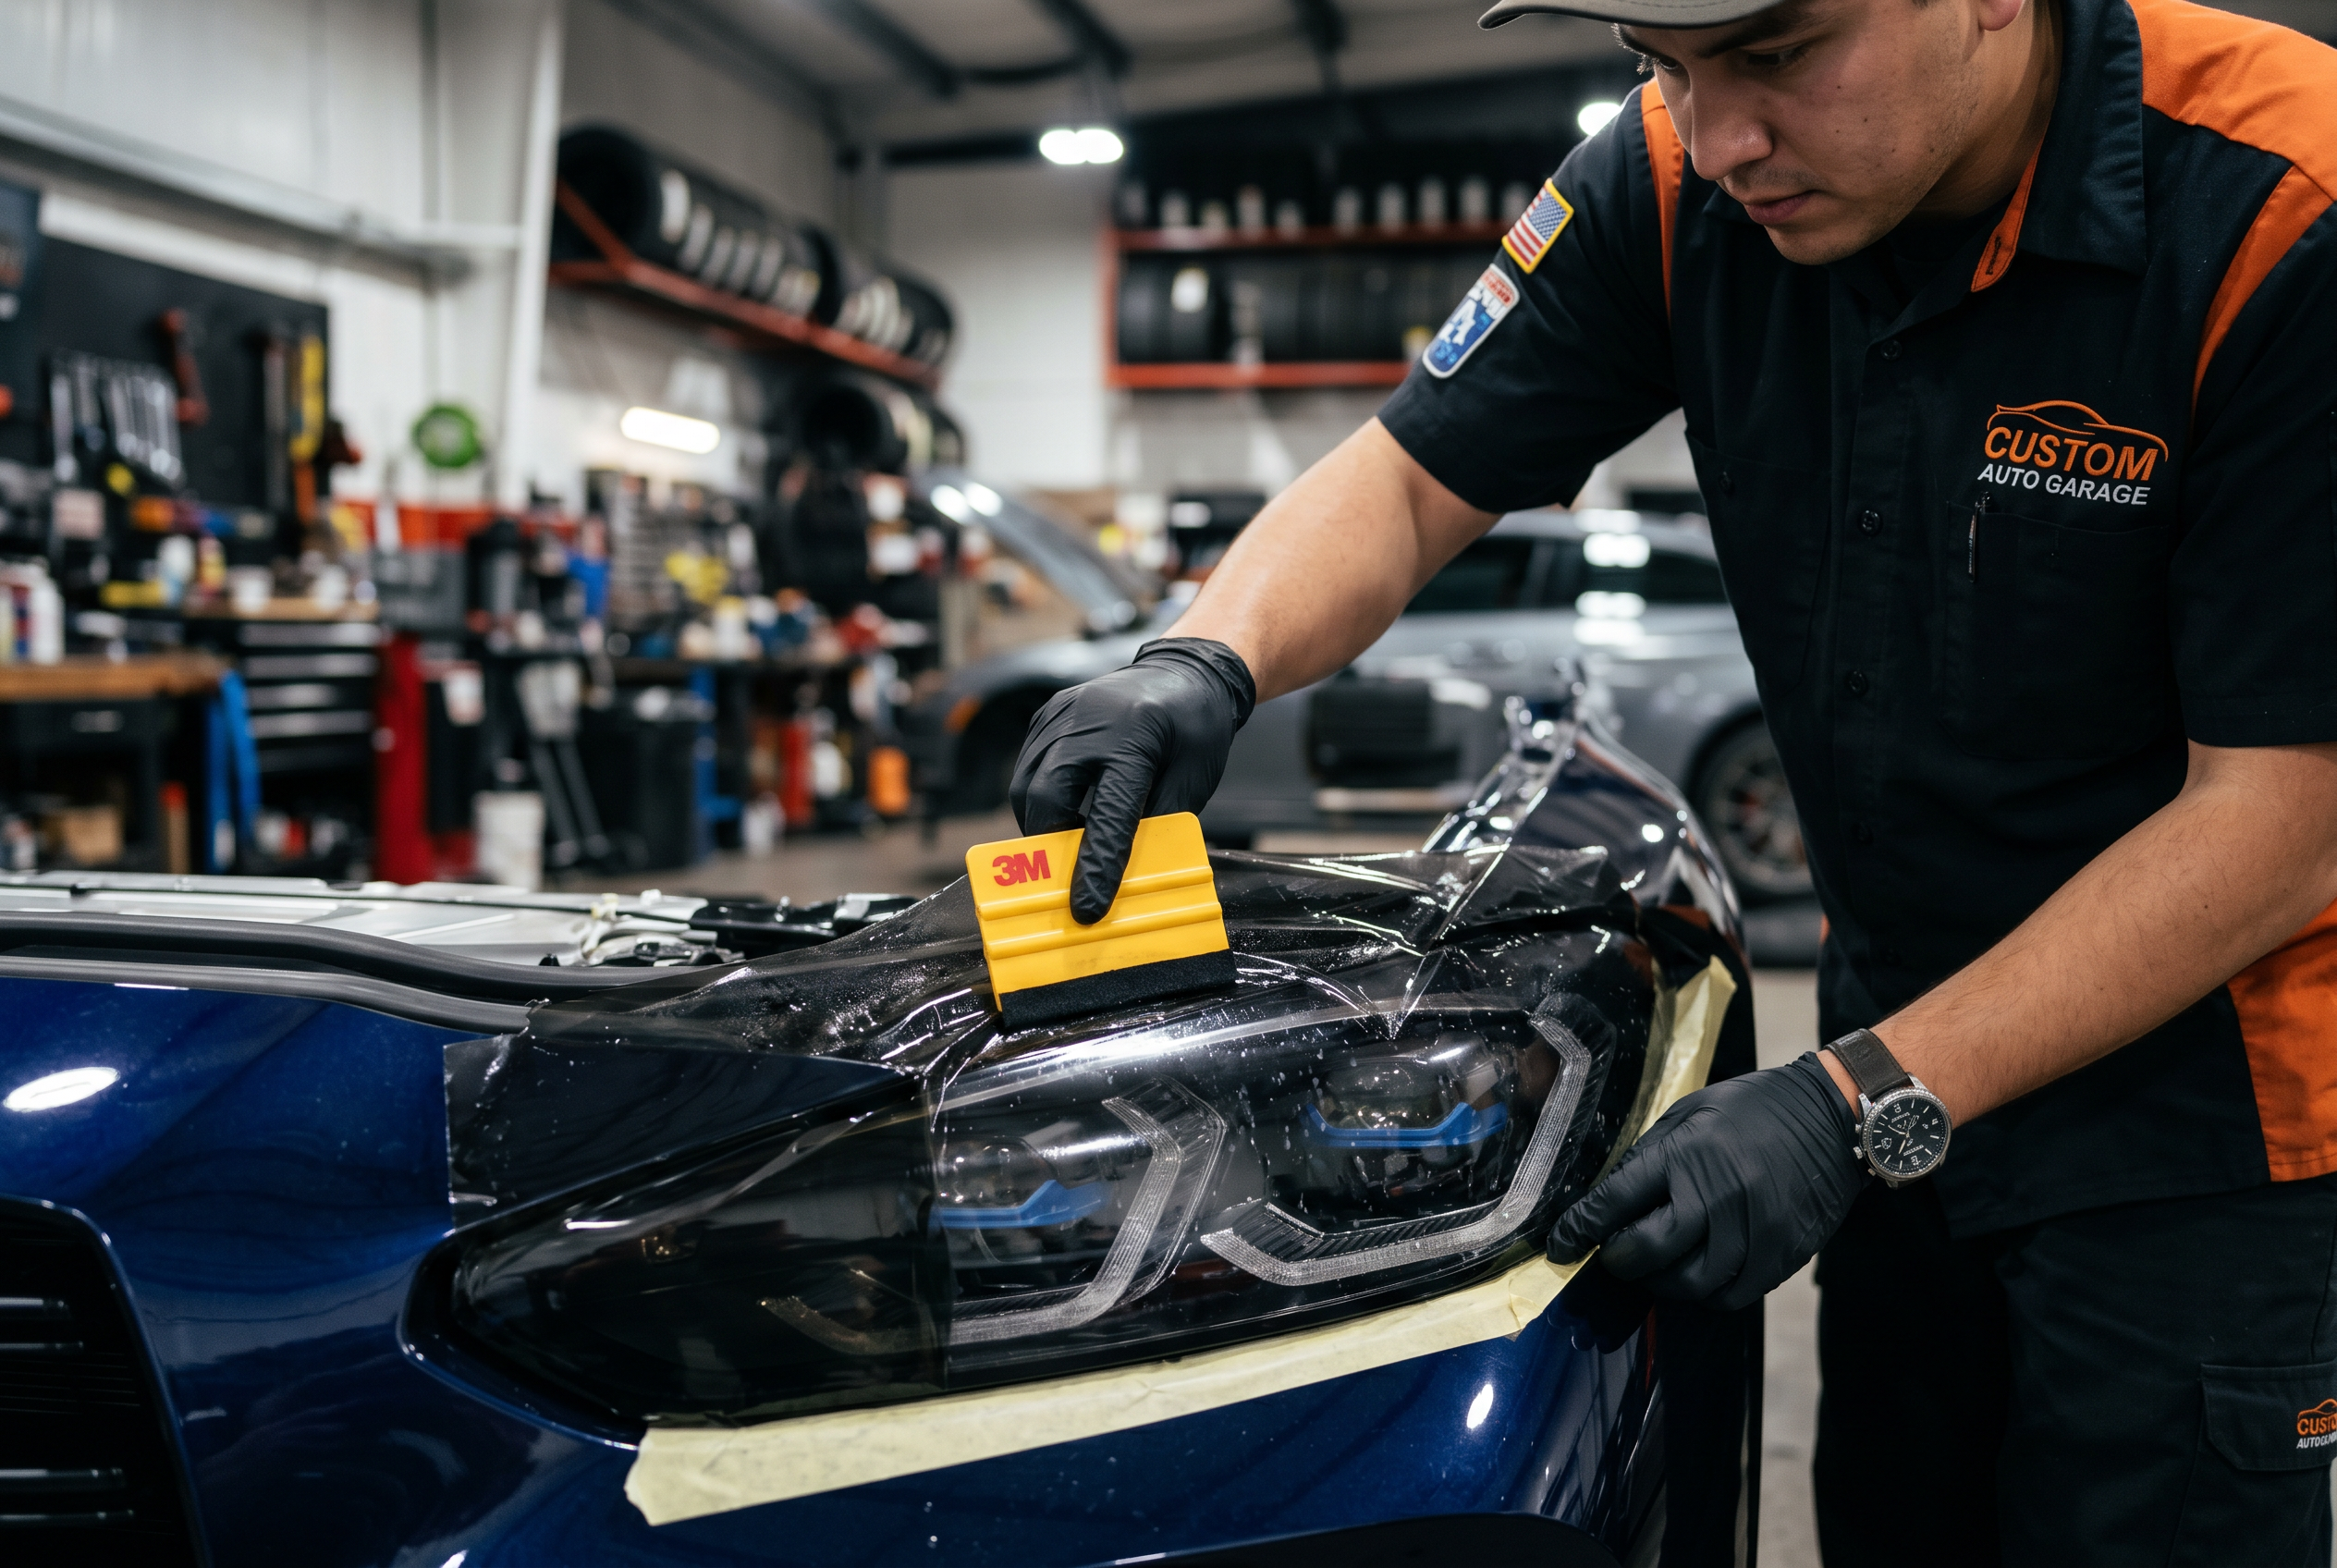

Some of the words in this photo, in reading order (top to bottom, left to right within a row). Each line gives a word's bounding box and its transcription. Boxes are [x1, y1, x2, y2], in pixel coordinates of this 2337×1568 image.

[1984, 426, 2159, 481] CUSTOM
[1977, 463, 2040, 489] AUTO
[2045, 474, 2151, 505] GARAGE
[992, 849, 1051, 887] 3M
